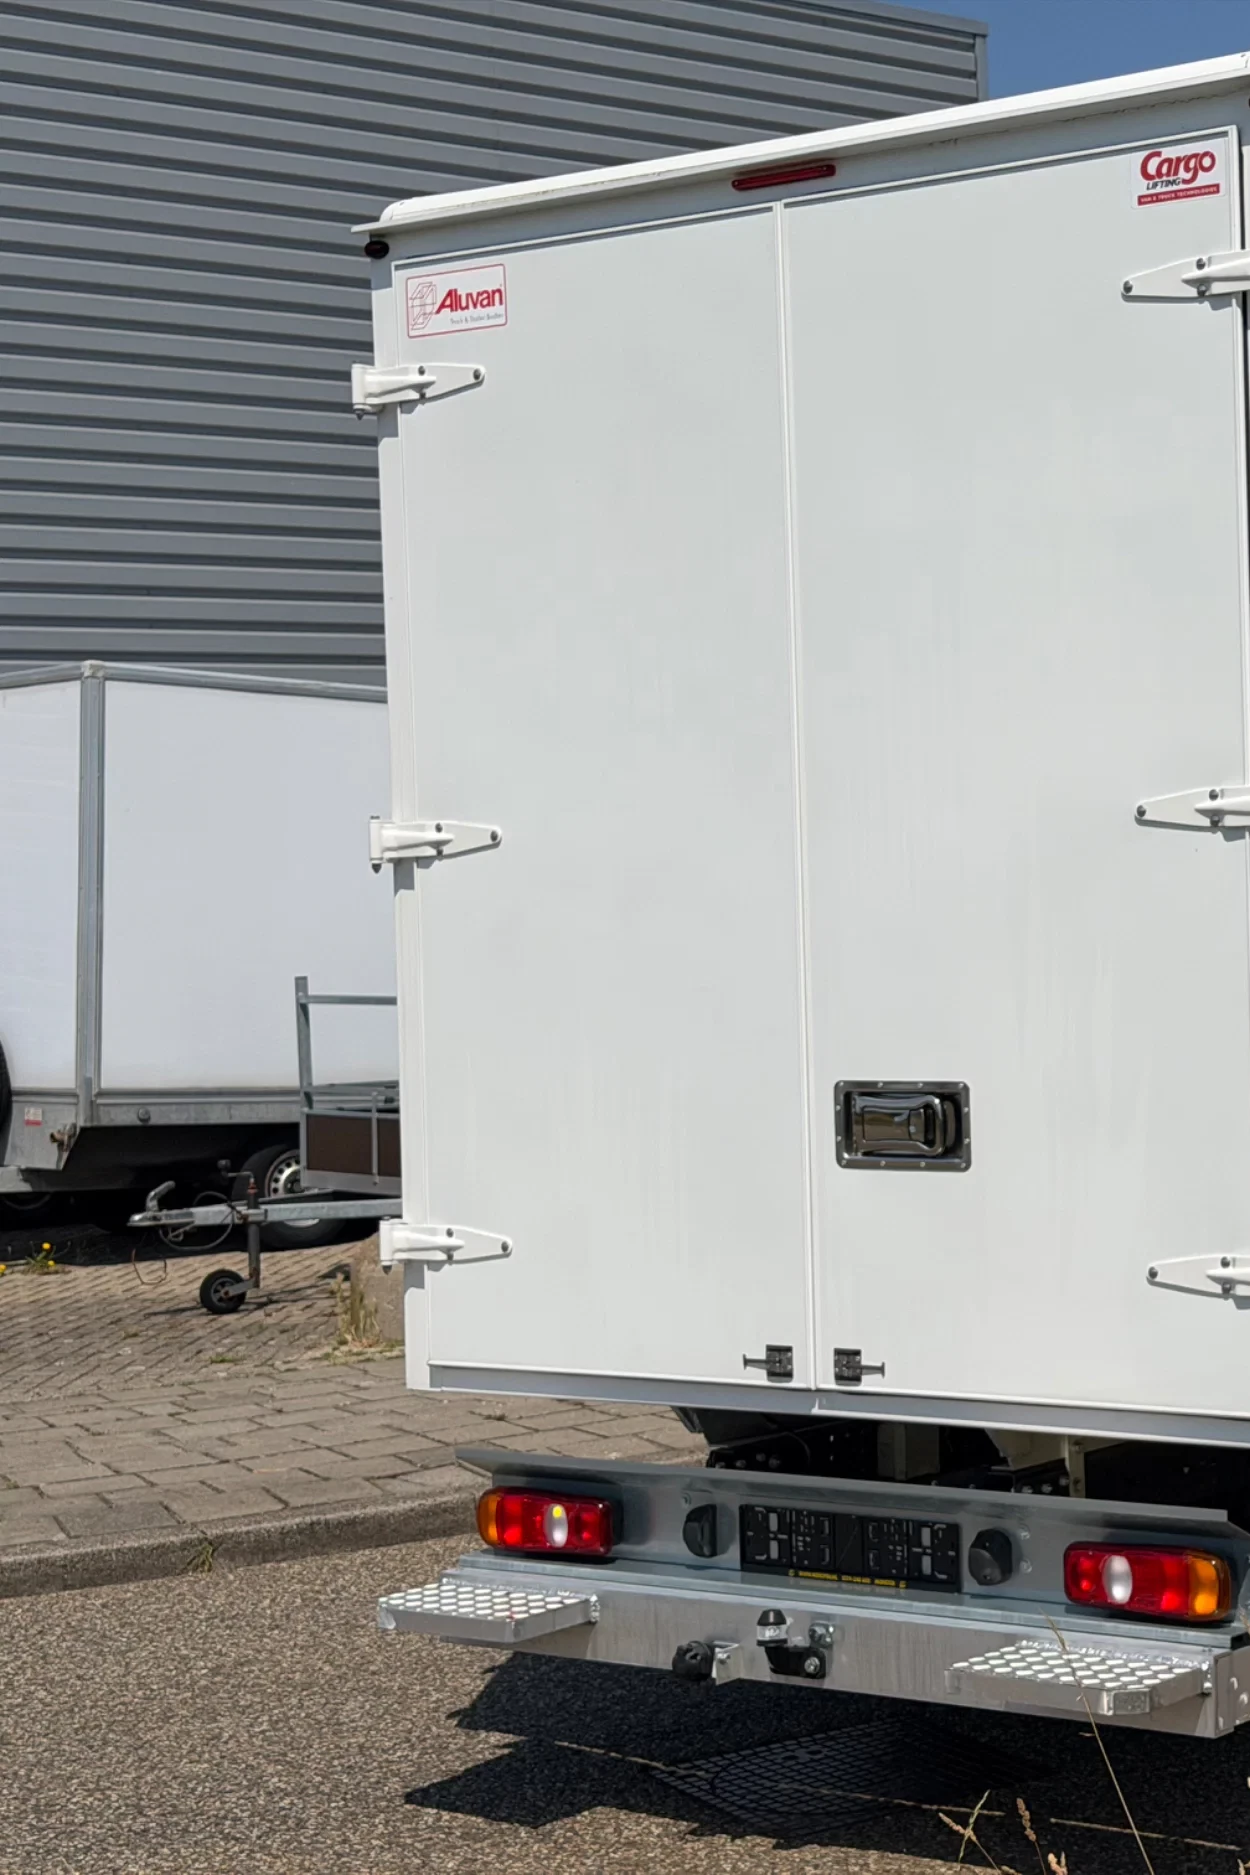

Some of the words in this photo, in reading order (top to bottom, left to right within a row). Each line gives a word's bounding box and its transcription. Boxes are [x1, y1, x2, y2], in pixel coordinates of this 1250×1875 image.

[1140, 150, 1216, 185] Cargo
[1146, 177, 1181, 191] LIFTING
[435, 288, 503, 315] Aluvan
